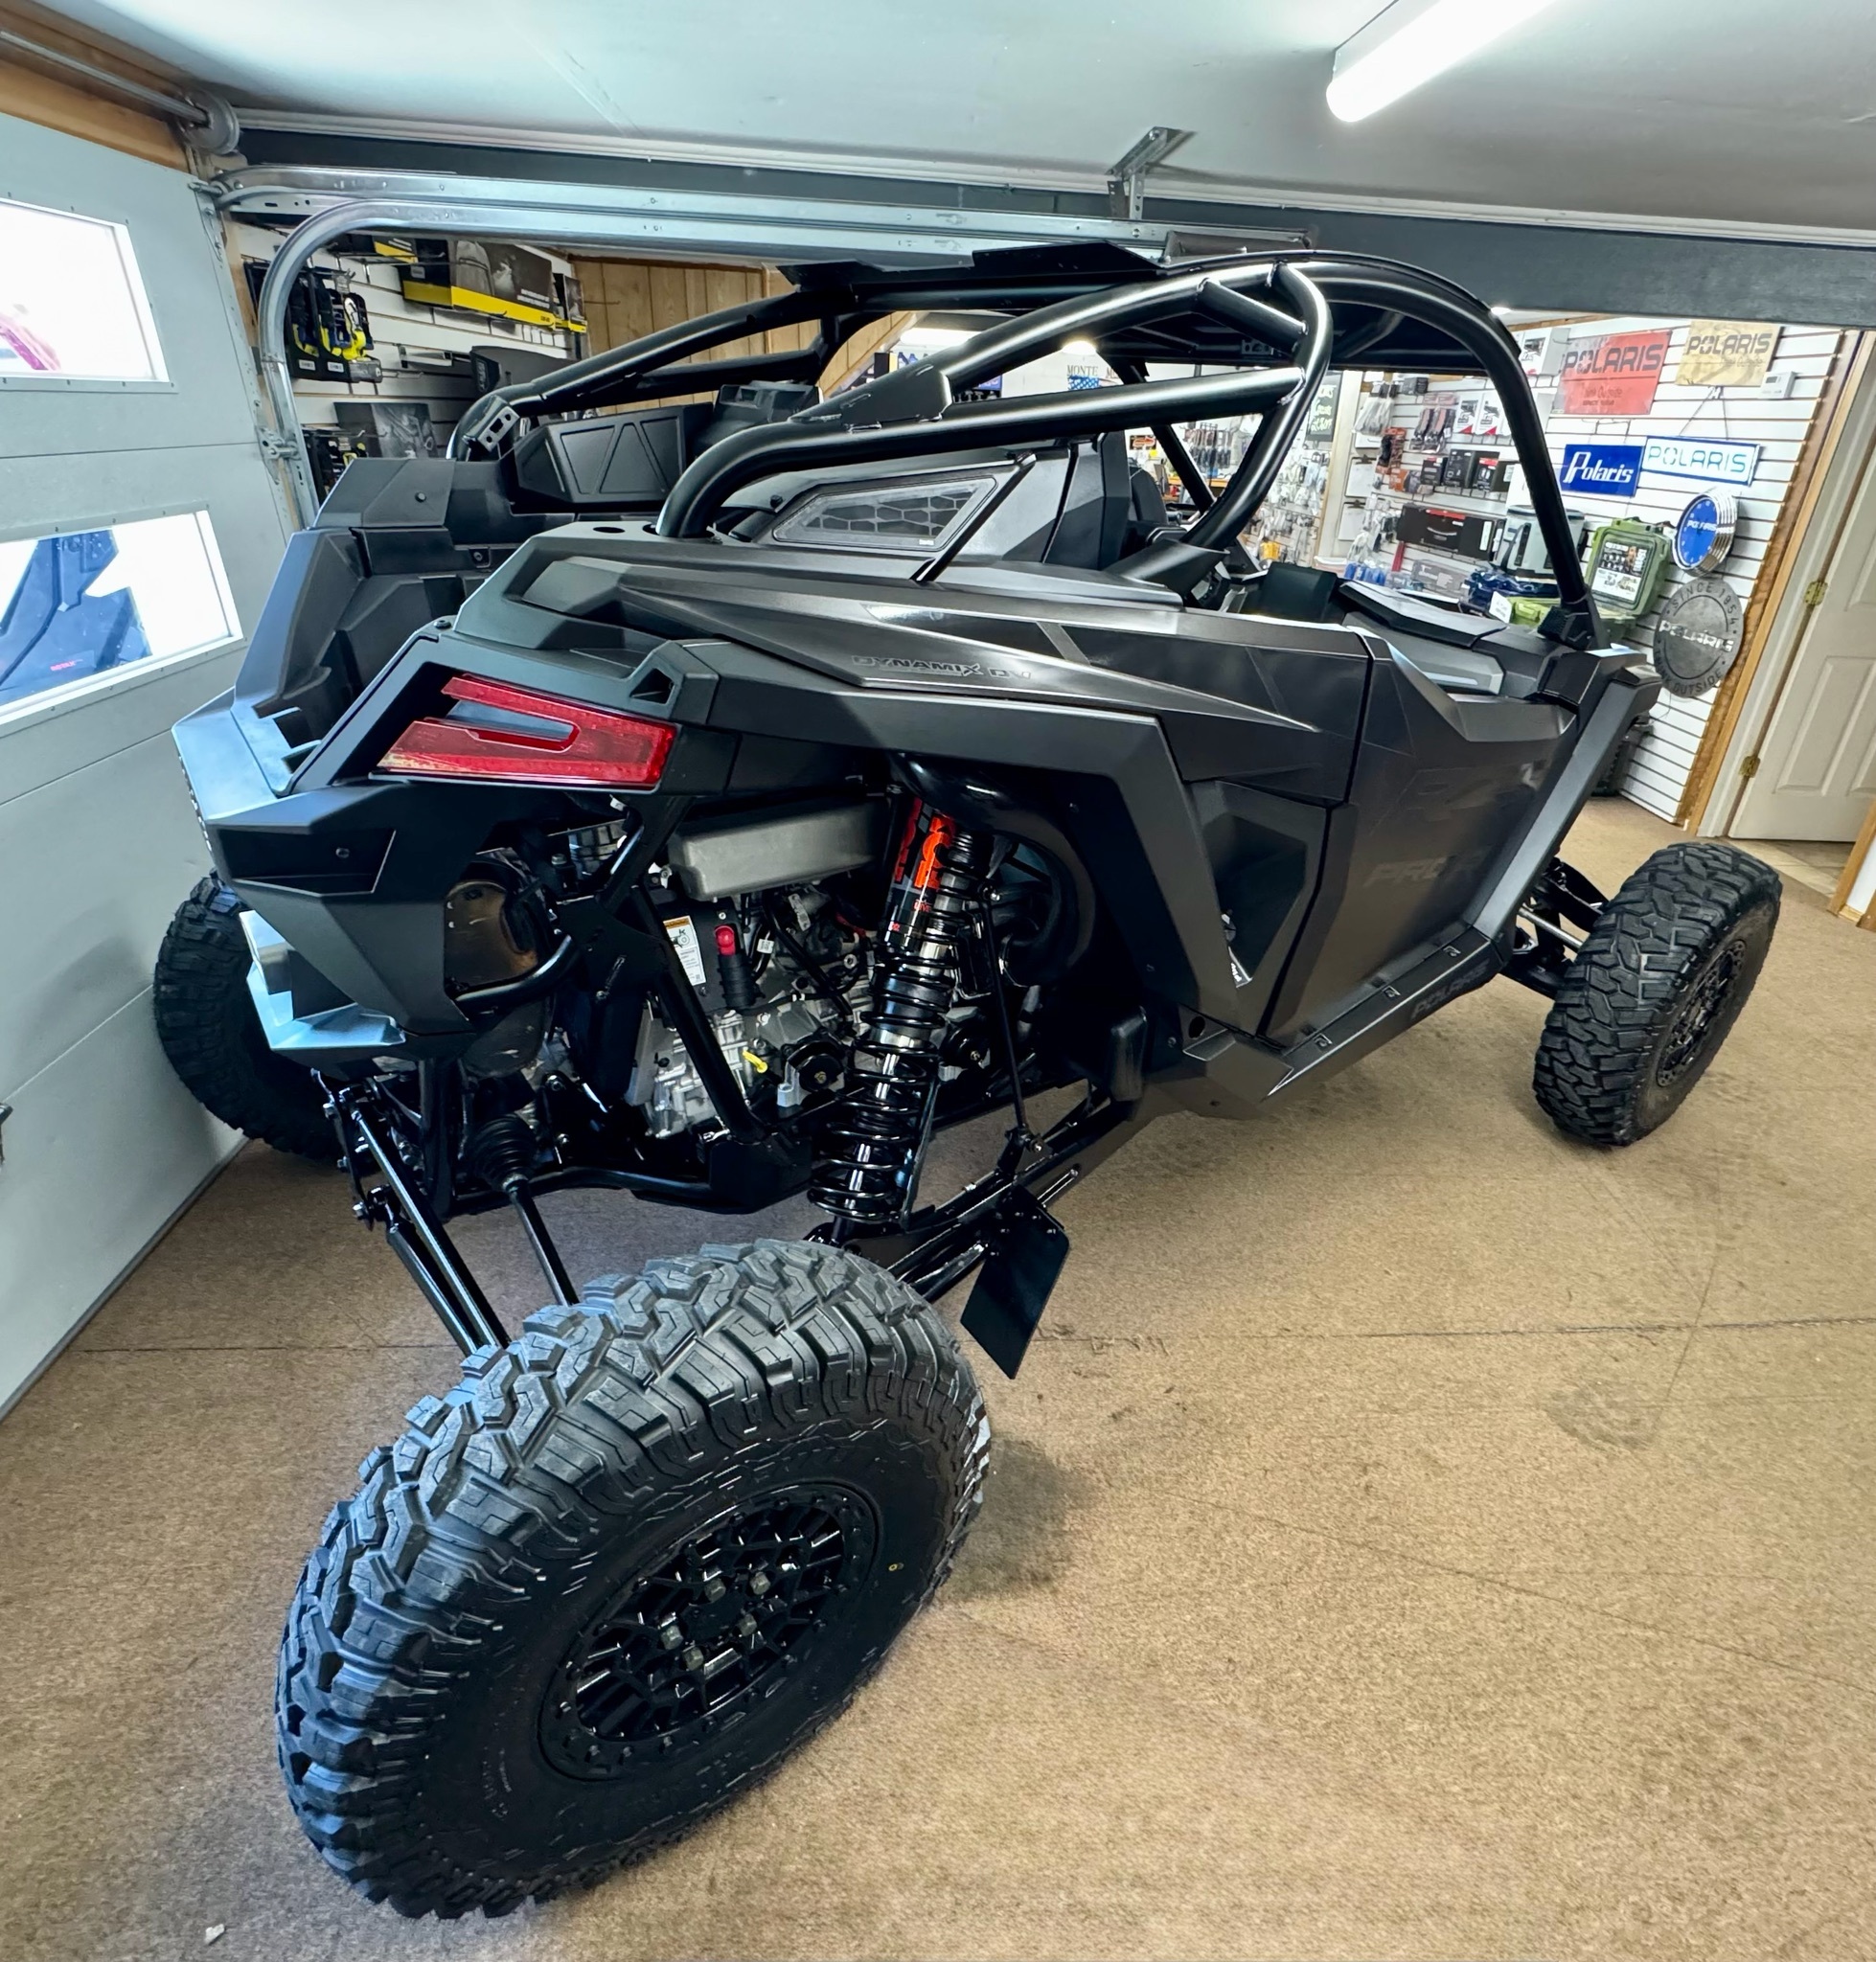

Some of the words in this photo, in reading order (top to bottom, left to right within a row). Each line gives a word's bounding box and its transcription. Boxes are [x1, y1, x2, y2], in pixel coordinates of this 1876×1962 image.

[1686, 332, 1773, 355] POLARIS
[1067, 364, 1099, 376] MONTE
[1562, 344, 1664, 375] POLARIS
[1563, 451, 1635, 484] Polaris
[1647, 445, 1748, 473] POLARIS
[1671, 581, 1715, 609] SINCE
[1718, 588, 1740, 625] 1954
[1659, 620, 1734, 652] POLARIS
[852, 654, 984, 676] DYNAMIX
[1673, 670, 1724, 695] OUTSIDE
